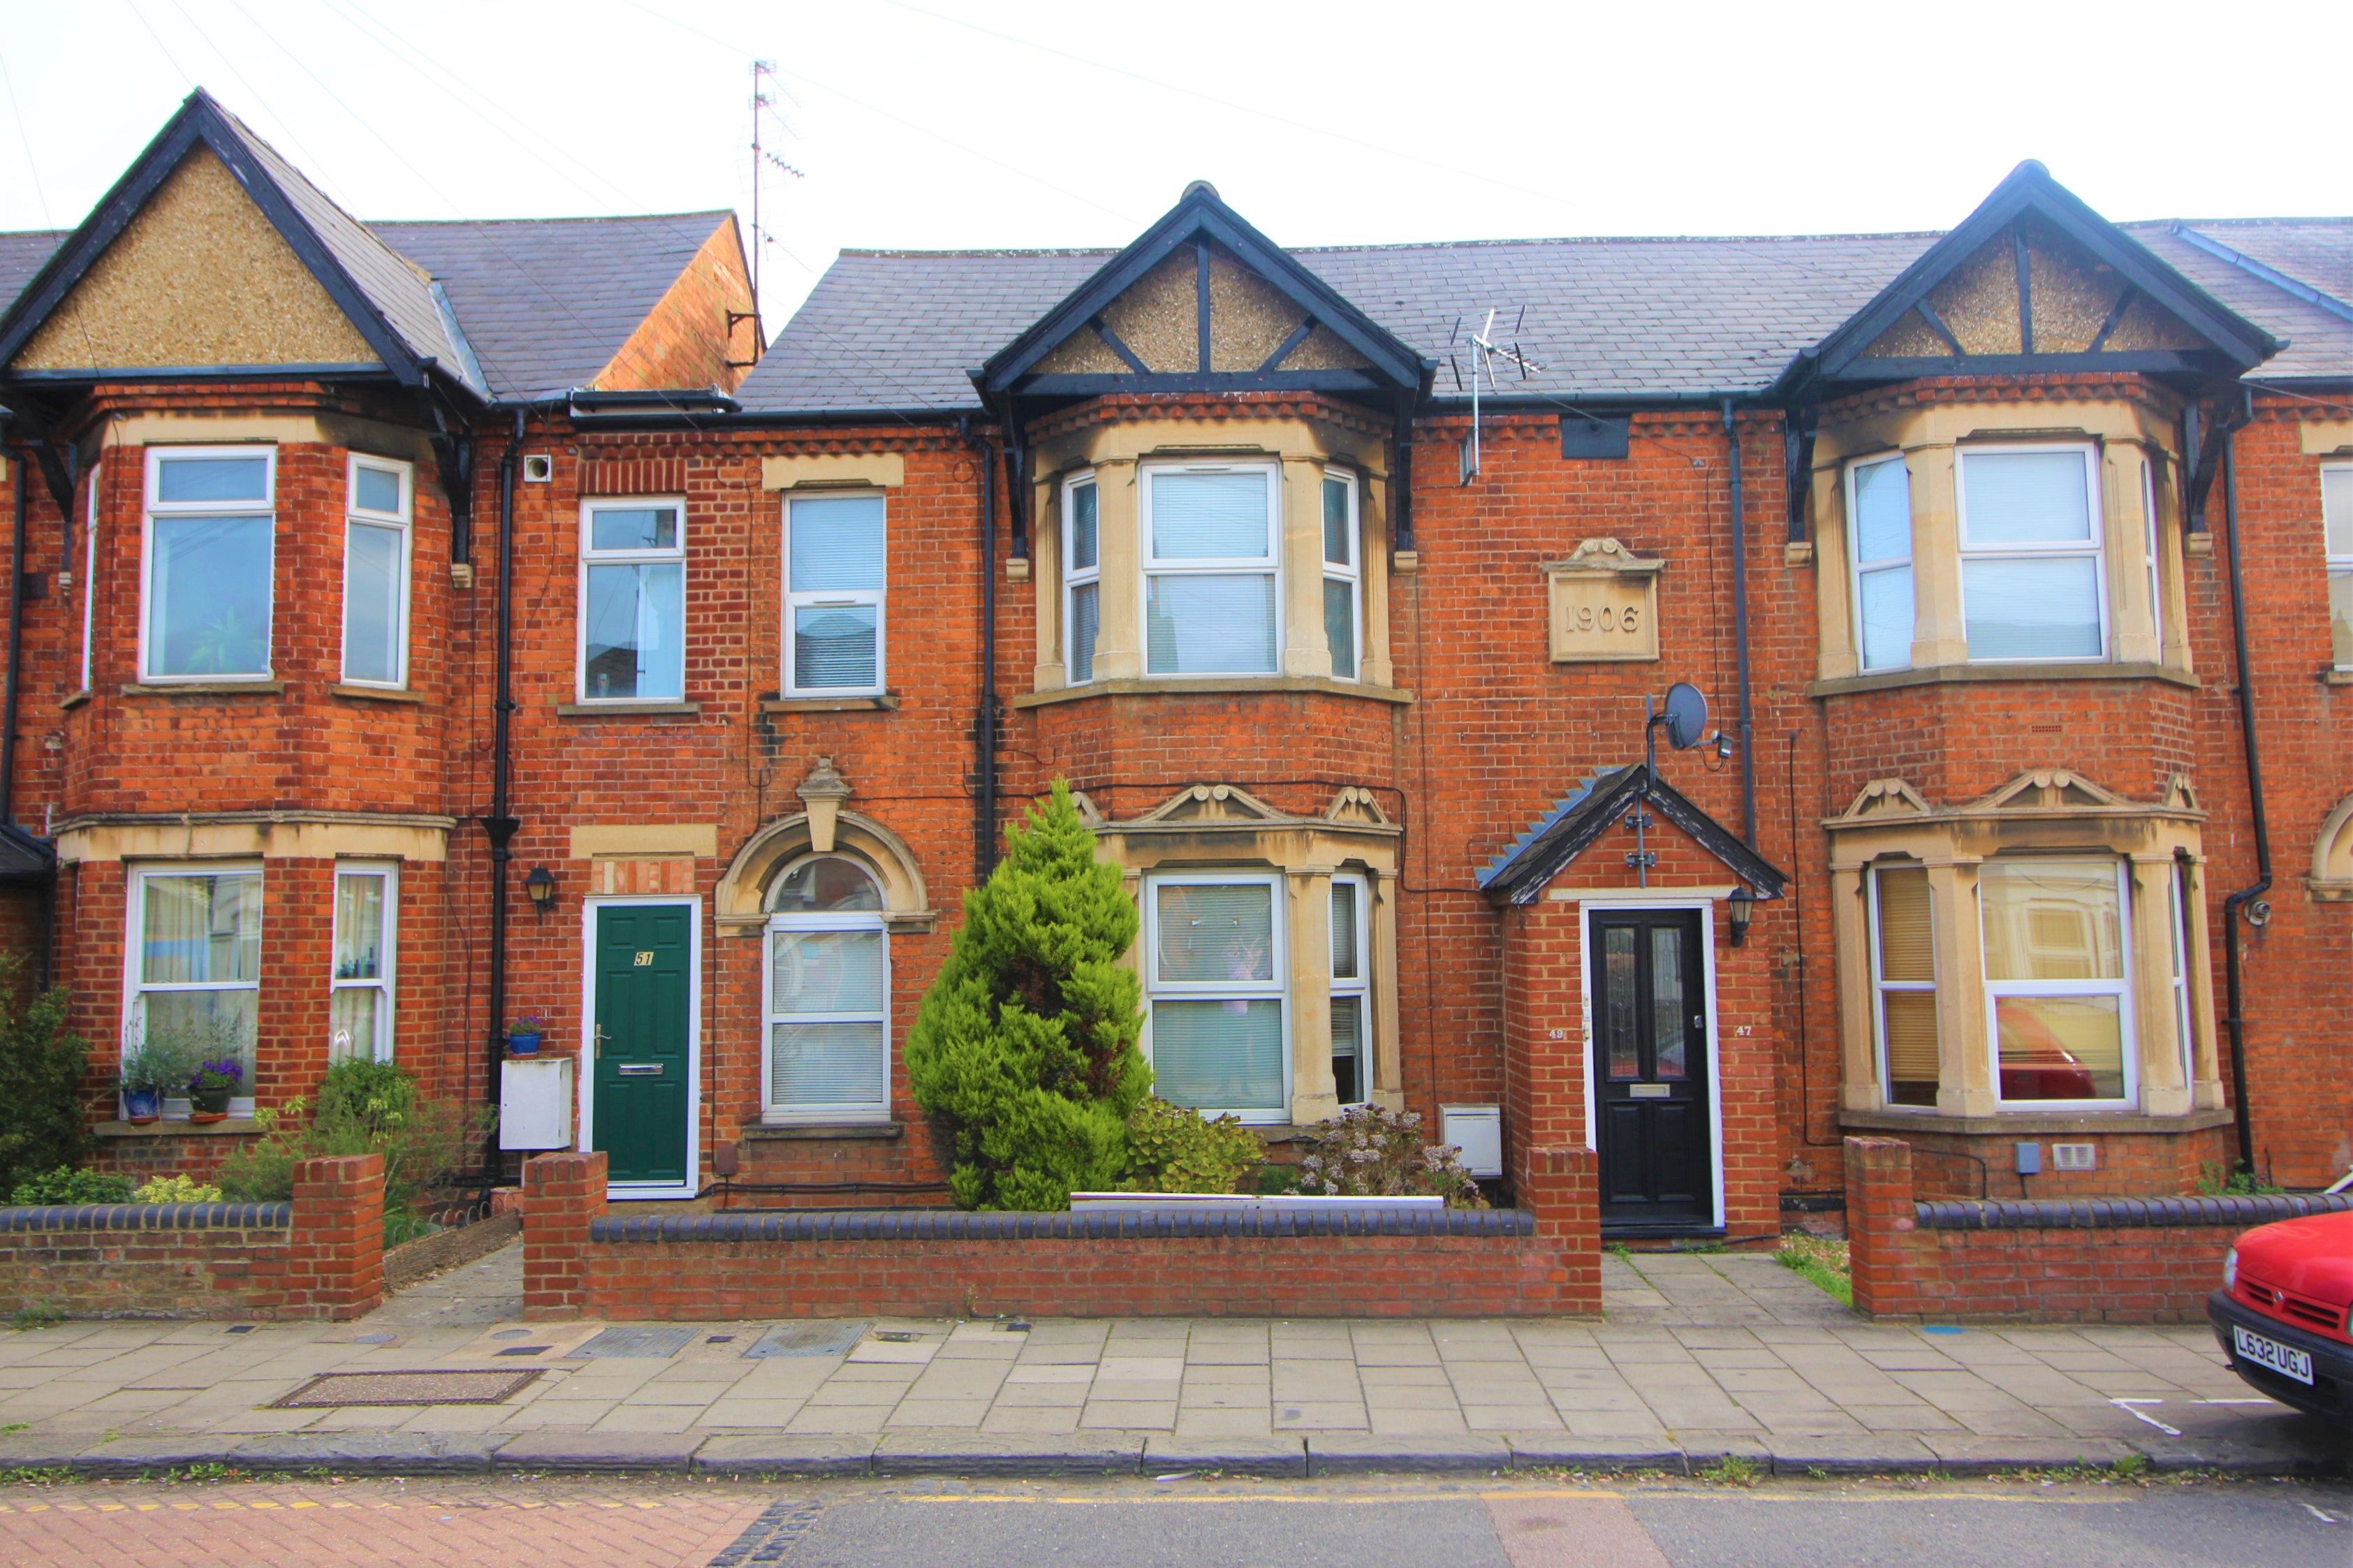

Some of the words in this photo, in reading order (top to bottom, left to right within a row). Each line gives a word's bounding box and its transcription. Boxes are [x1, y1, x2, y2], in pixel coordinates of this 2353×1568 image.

[1565, 604, 1639, 633] 1906
[636, 953, 651, 965] 51
[1549, 1030, 1564, 1039] 49
[1736, 1026, 1752, 1036] 47
[2236, 1329, 2275, 1365] L632
[2277, 1345, 2309, 1377] UGJ
